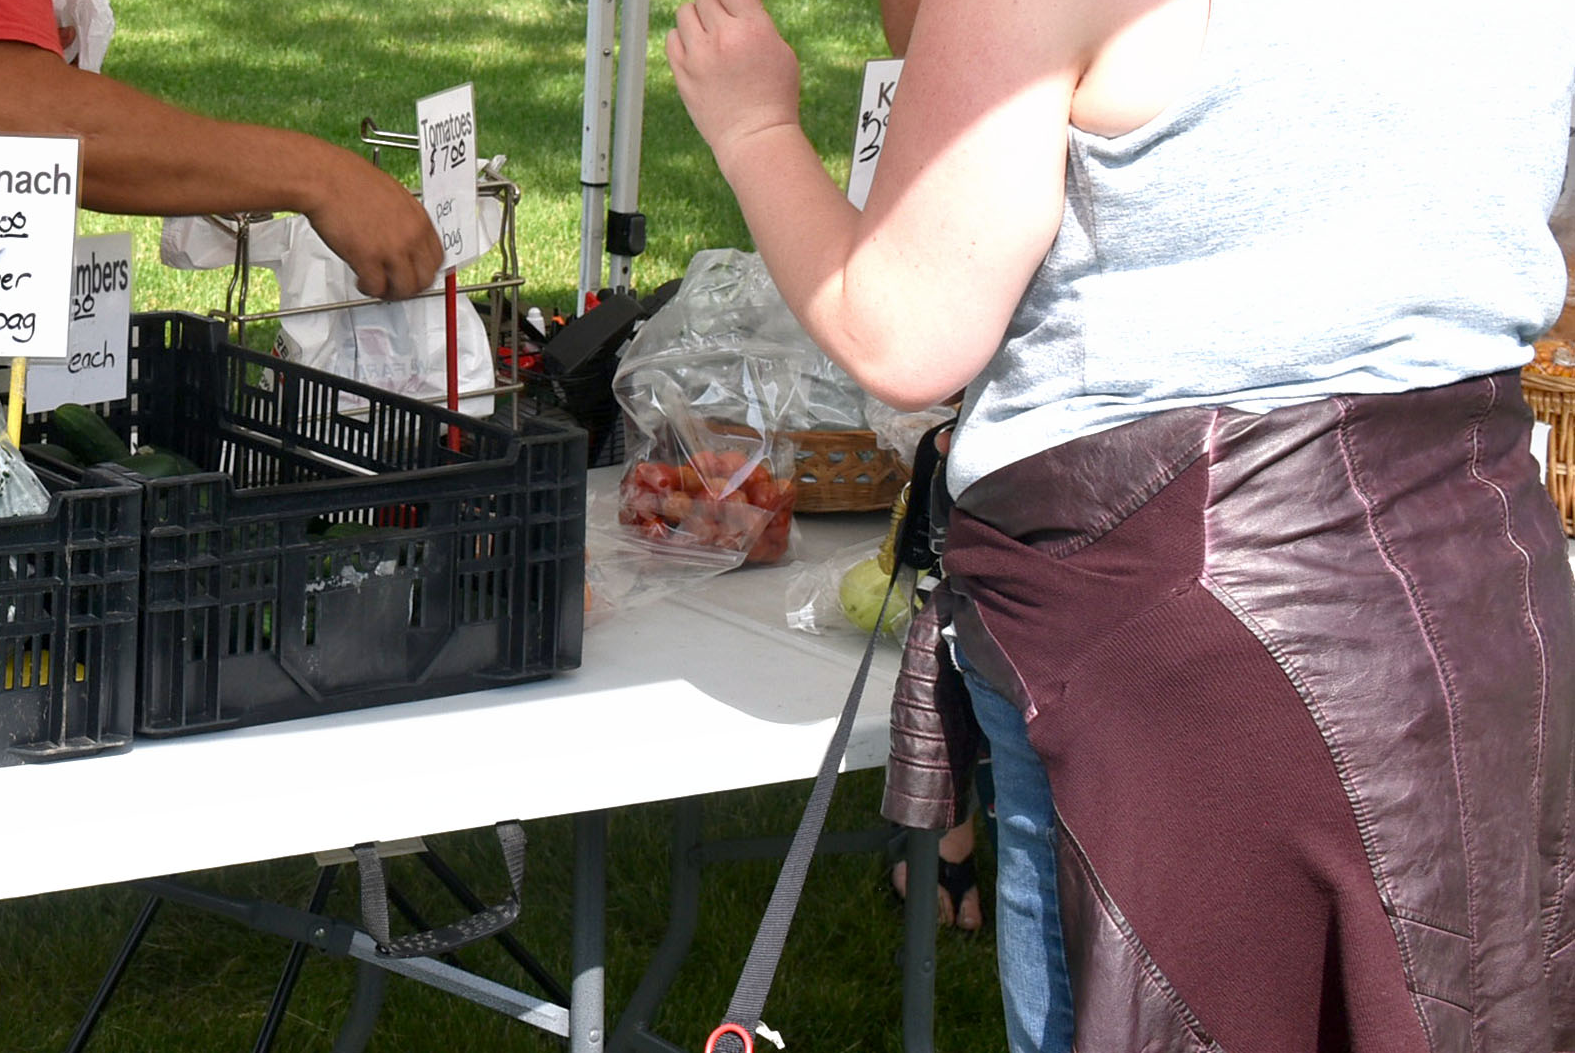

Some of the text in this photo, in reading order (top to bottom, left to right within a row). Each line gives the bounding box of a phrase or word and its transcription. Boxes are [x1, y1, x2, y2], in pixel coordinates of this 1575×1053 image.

[420, 111, 473, 151] Tomatoes
[435, 197, 456, 225] per
[441, 226, 463, 256] bag
[67, 340, 115, 374] each
